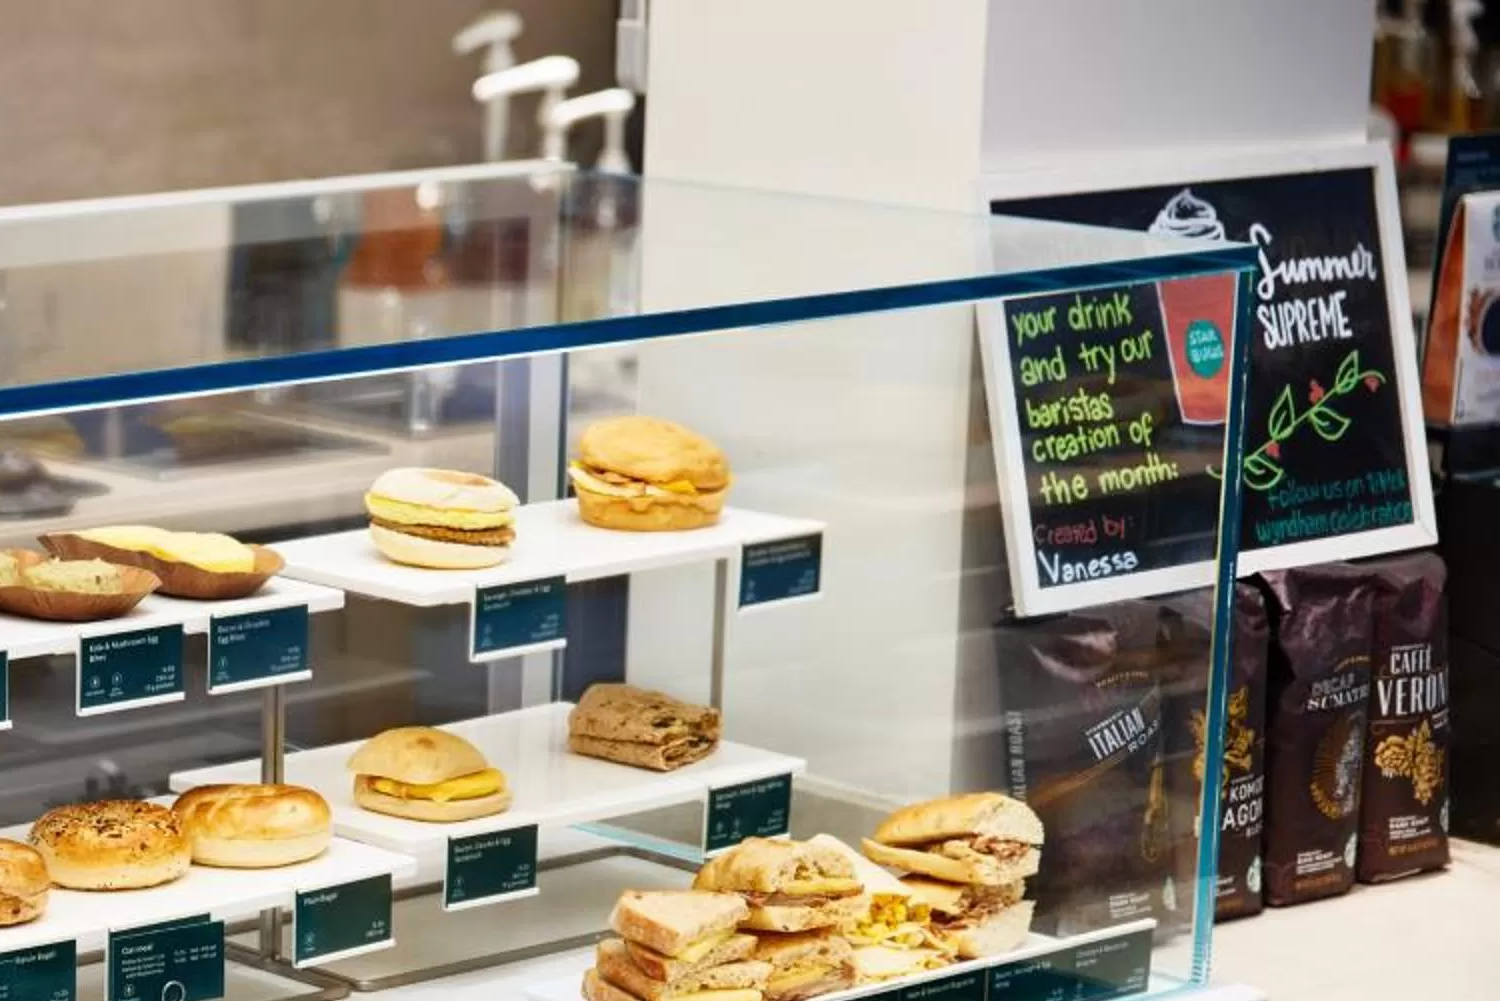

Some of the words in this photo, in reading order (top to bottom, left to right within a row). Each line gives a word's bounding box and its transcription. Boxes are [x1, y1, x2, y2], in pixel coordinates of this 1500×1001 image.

[1250, 223, 1377, 300] Summer
[1012, 306, 1056, 346] your
[1068, 292, 1133, 331] drink
[1257, 291, 1353, 349] SUPREME
[1019, 346, 1067, 387] and
[1078, 342, 1116, 384] try
[1121, 329, 1154, 363] our
[1025, 388, 1114, 429] baristas
[1032, 424, 1119, 463] creation
[1129, 412, 1153, 447] of
[1040, 471, 1088, 505] the
[1098, 453, 1179, 493] month:
[1034, 520, 1099, 546] Created
[1037, 550, 1140, 585] Vanessa
[1377, 671, 1449, 717] VERON
[1087, 707, 1146, 761] ITALIAN
